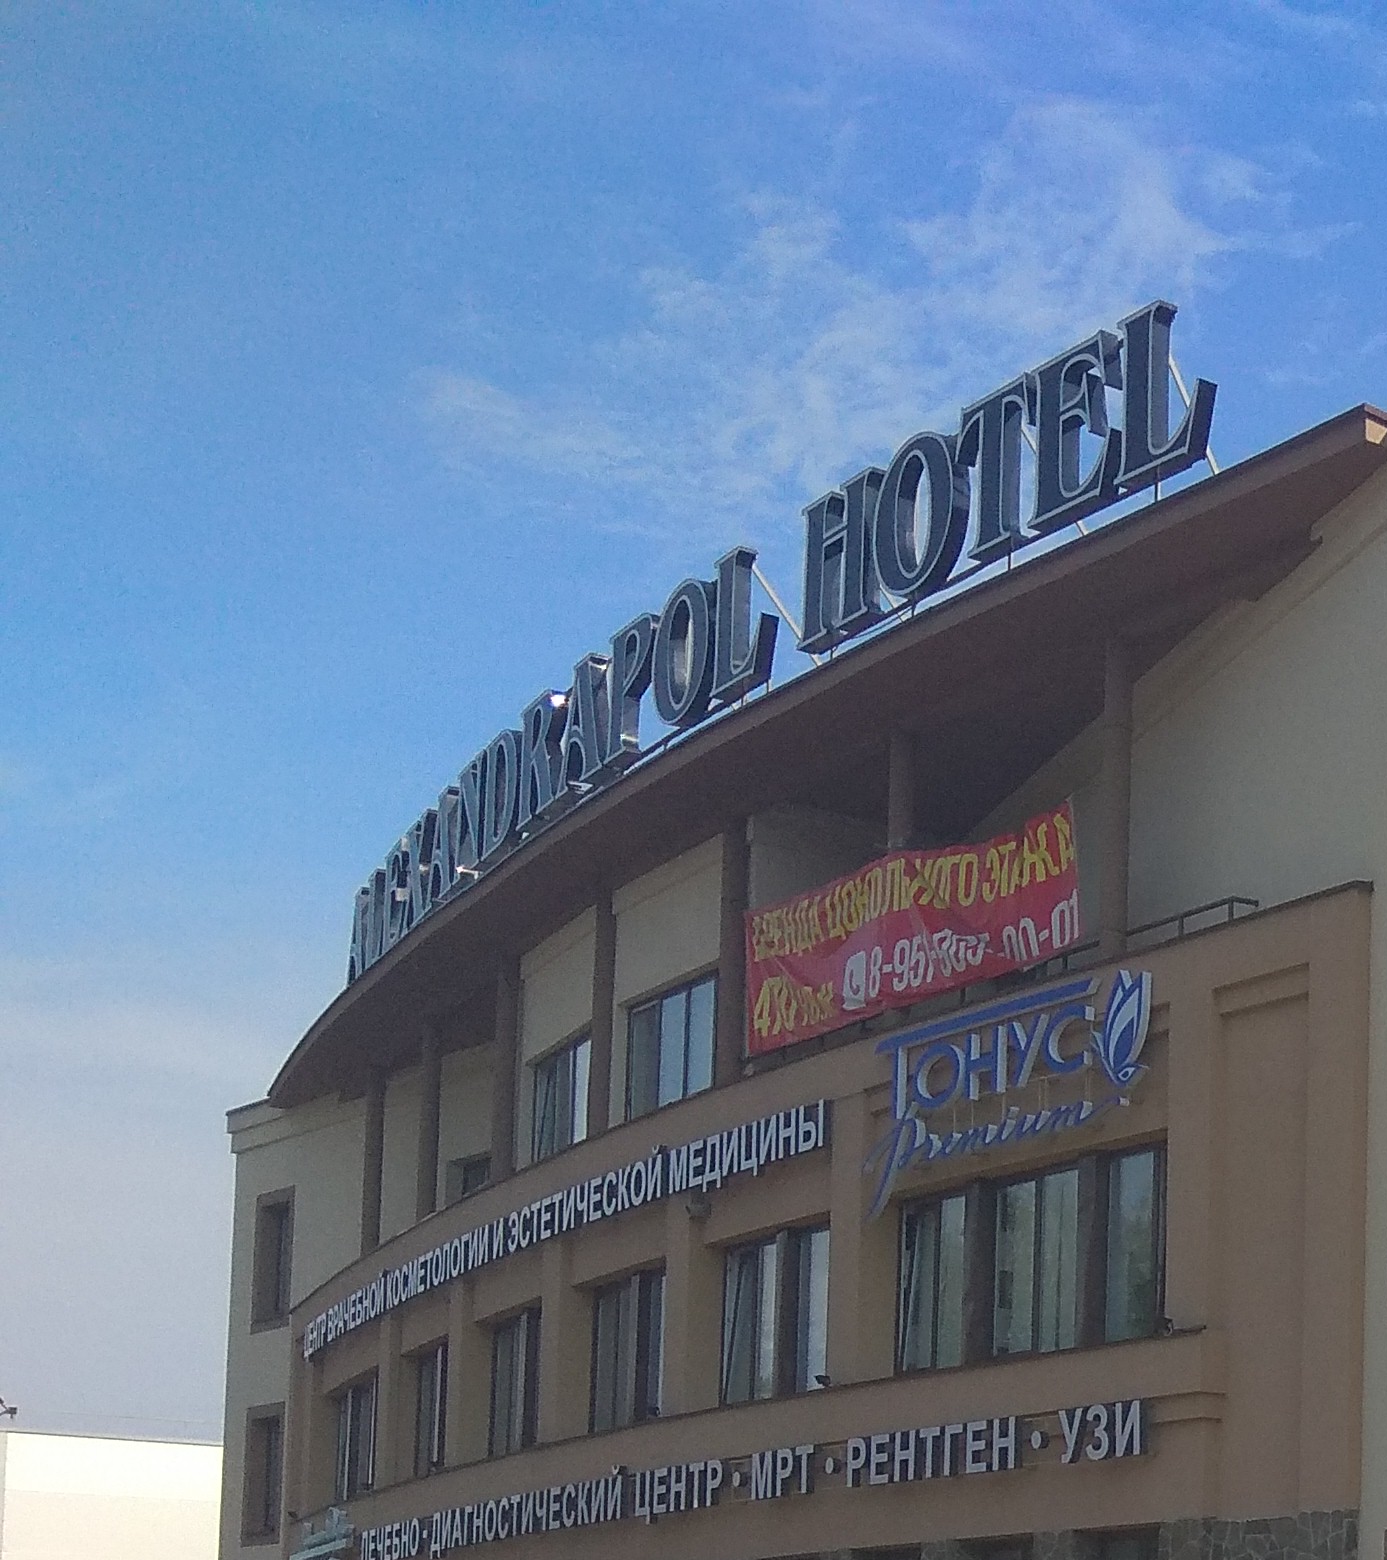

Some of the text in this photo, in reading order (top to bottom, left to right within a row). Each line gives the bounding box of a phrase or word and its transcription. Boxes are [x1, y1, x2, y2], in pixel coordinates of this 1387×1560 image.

[797, 300, 1217, 655] HOTEL
[876, 977, 1101, 1119] ТОНУС
[303, 1099, 825, 1362] ЦЕНТР ВРАЧЕБНОЙ КОСМЕТОЛОГИИ И ЭСТЕТИЧЕСКОЙ МЕДИЦИНЫ
[634, 1460, 724, 1525] ЦЕНТР
[751, 1444, 815, 1500] МРТ
[846, 1416, 1016, 1488] РЕНТГЕН
[1058, 1400, 1141, 1464] УЗИ
